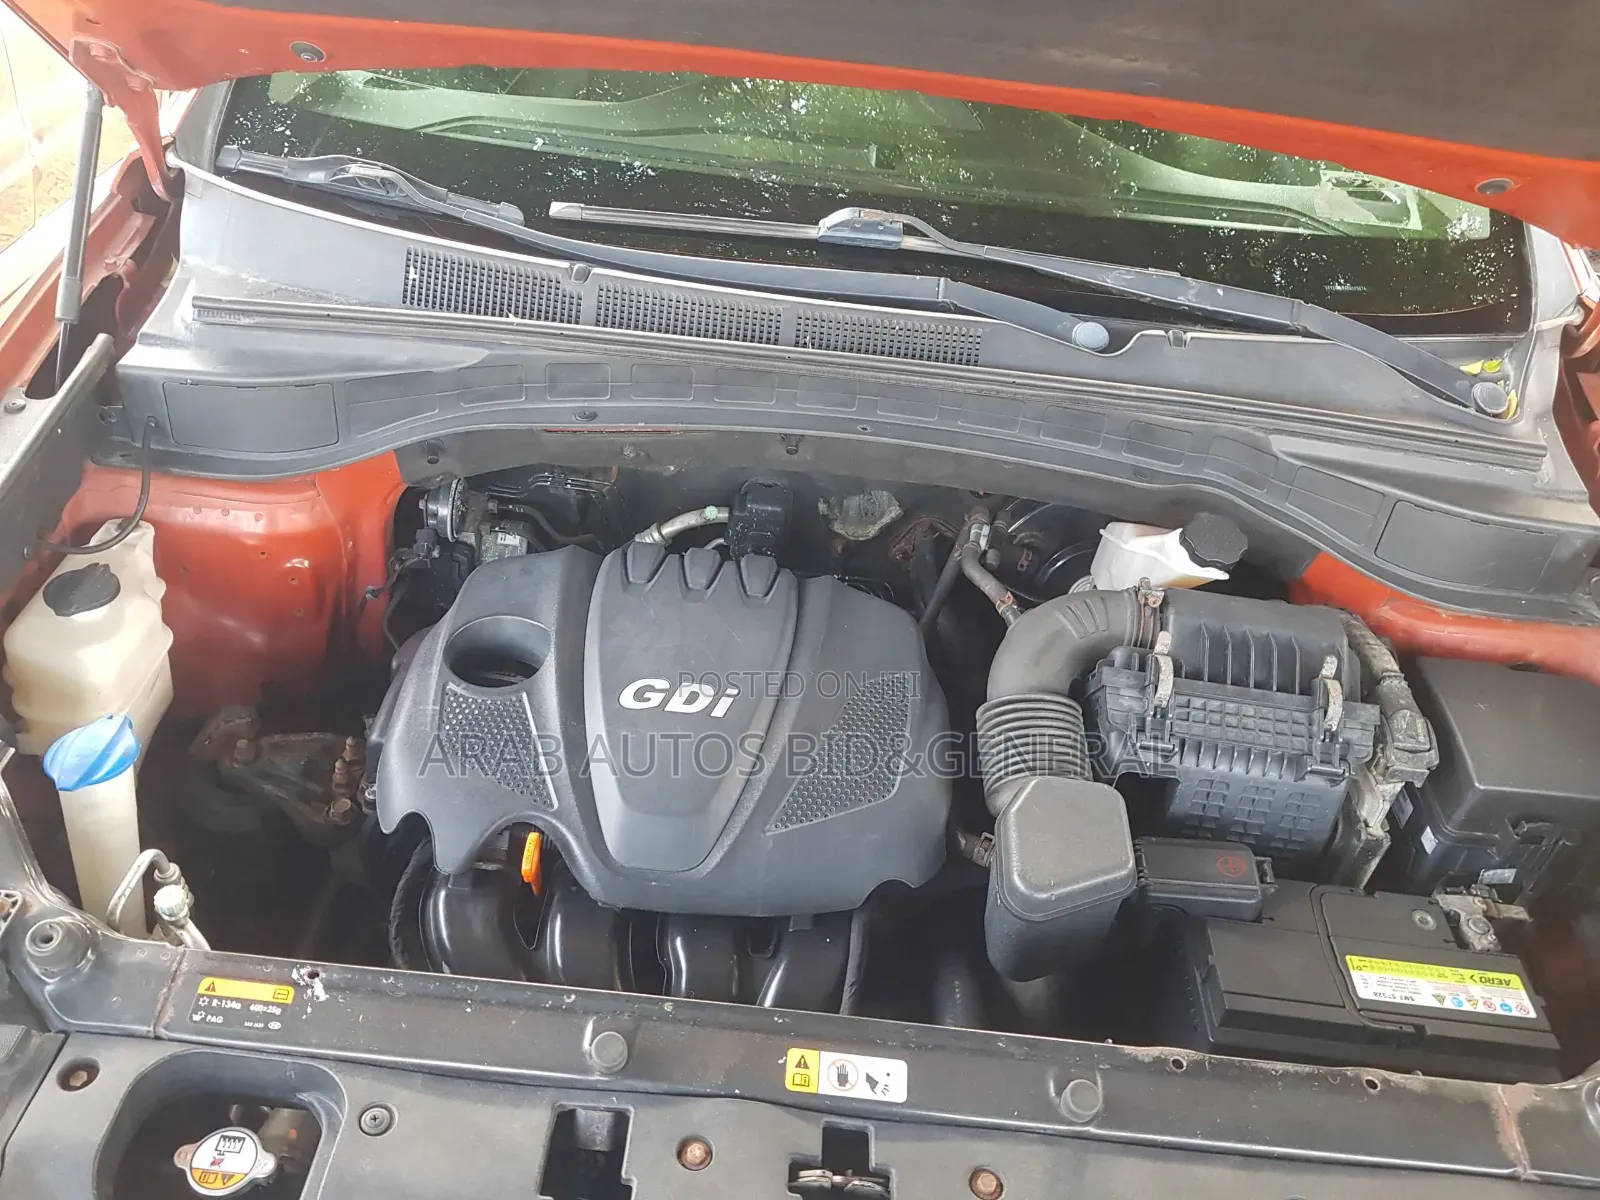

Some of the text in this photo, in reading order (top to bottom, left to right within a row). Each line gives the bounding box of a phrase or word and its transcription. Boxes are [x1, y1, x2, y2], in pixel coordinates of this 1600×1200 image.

[619, 678, 740, 718] GDi
[1479, 976, 1511, 987] AERO
[211, 998, 242, 1010] R-134a
[206, 1014, 224, 1024] PAG
